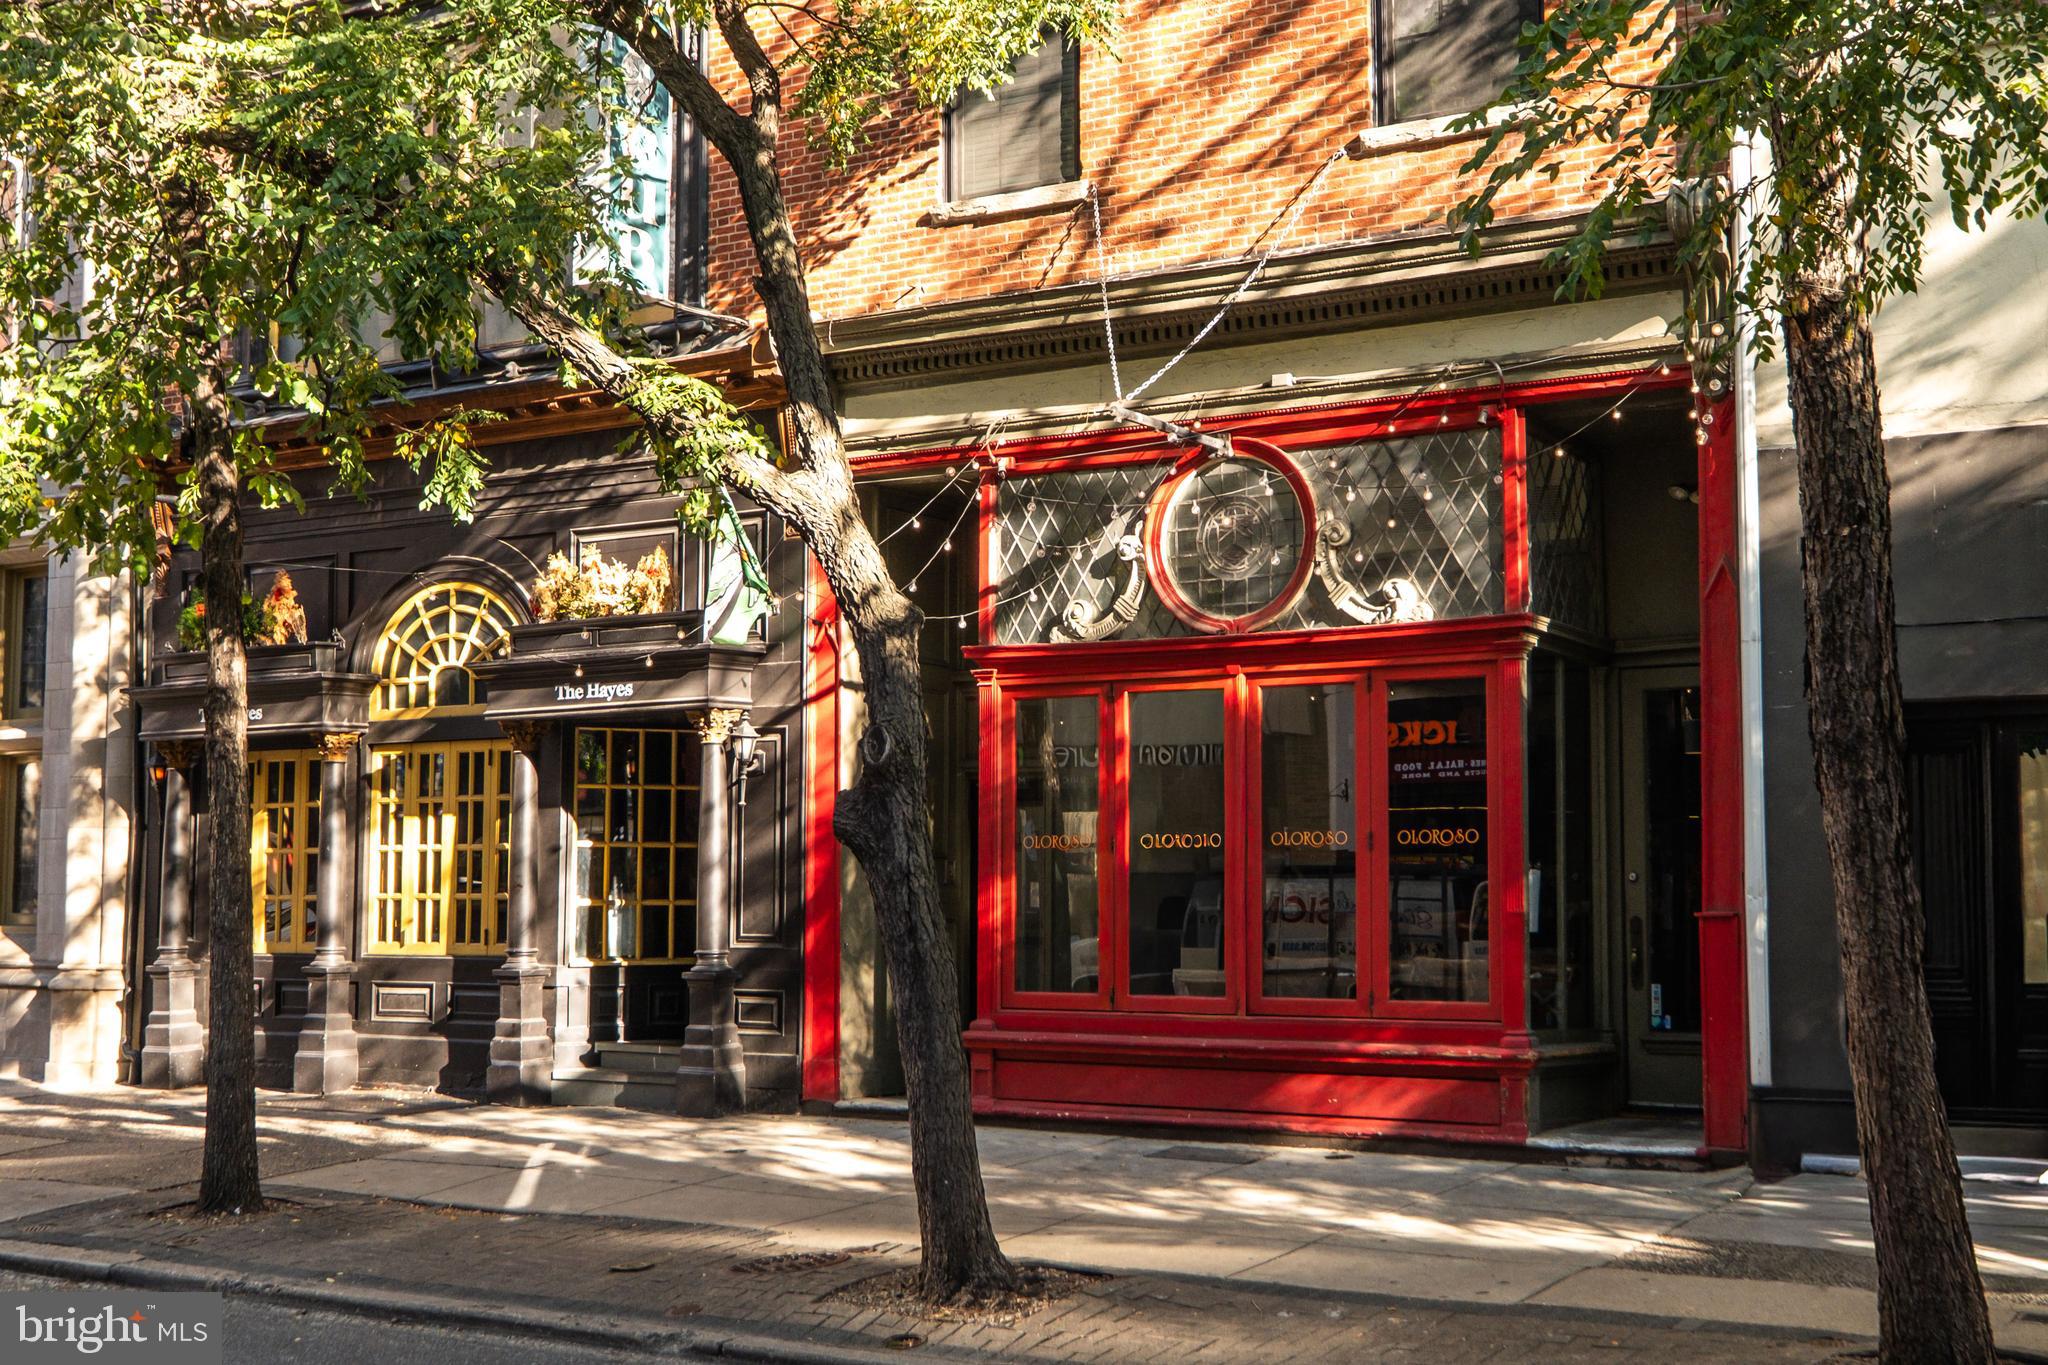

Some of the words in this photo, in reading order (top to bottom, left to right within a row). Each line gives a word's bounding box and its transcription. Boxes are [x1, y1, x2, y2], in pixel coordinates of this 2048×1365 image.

[555, 684, 584, 700] The
[586, 682, 634, 701] Hayes
[1023, 834, 1091, 851] OLOROSO
[1271, 830, 1348, 848] OLOROSO
[1397, 828, 1479, 847] OLOROSO
